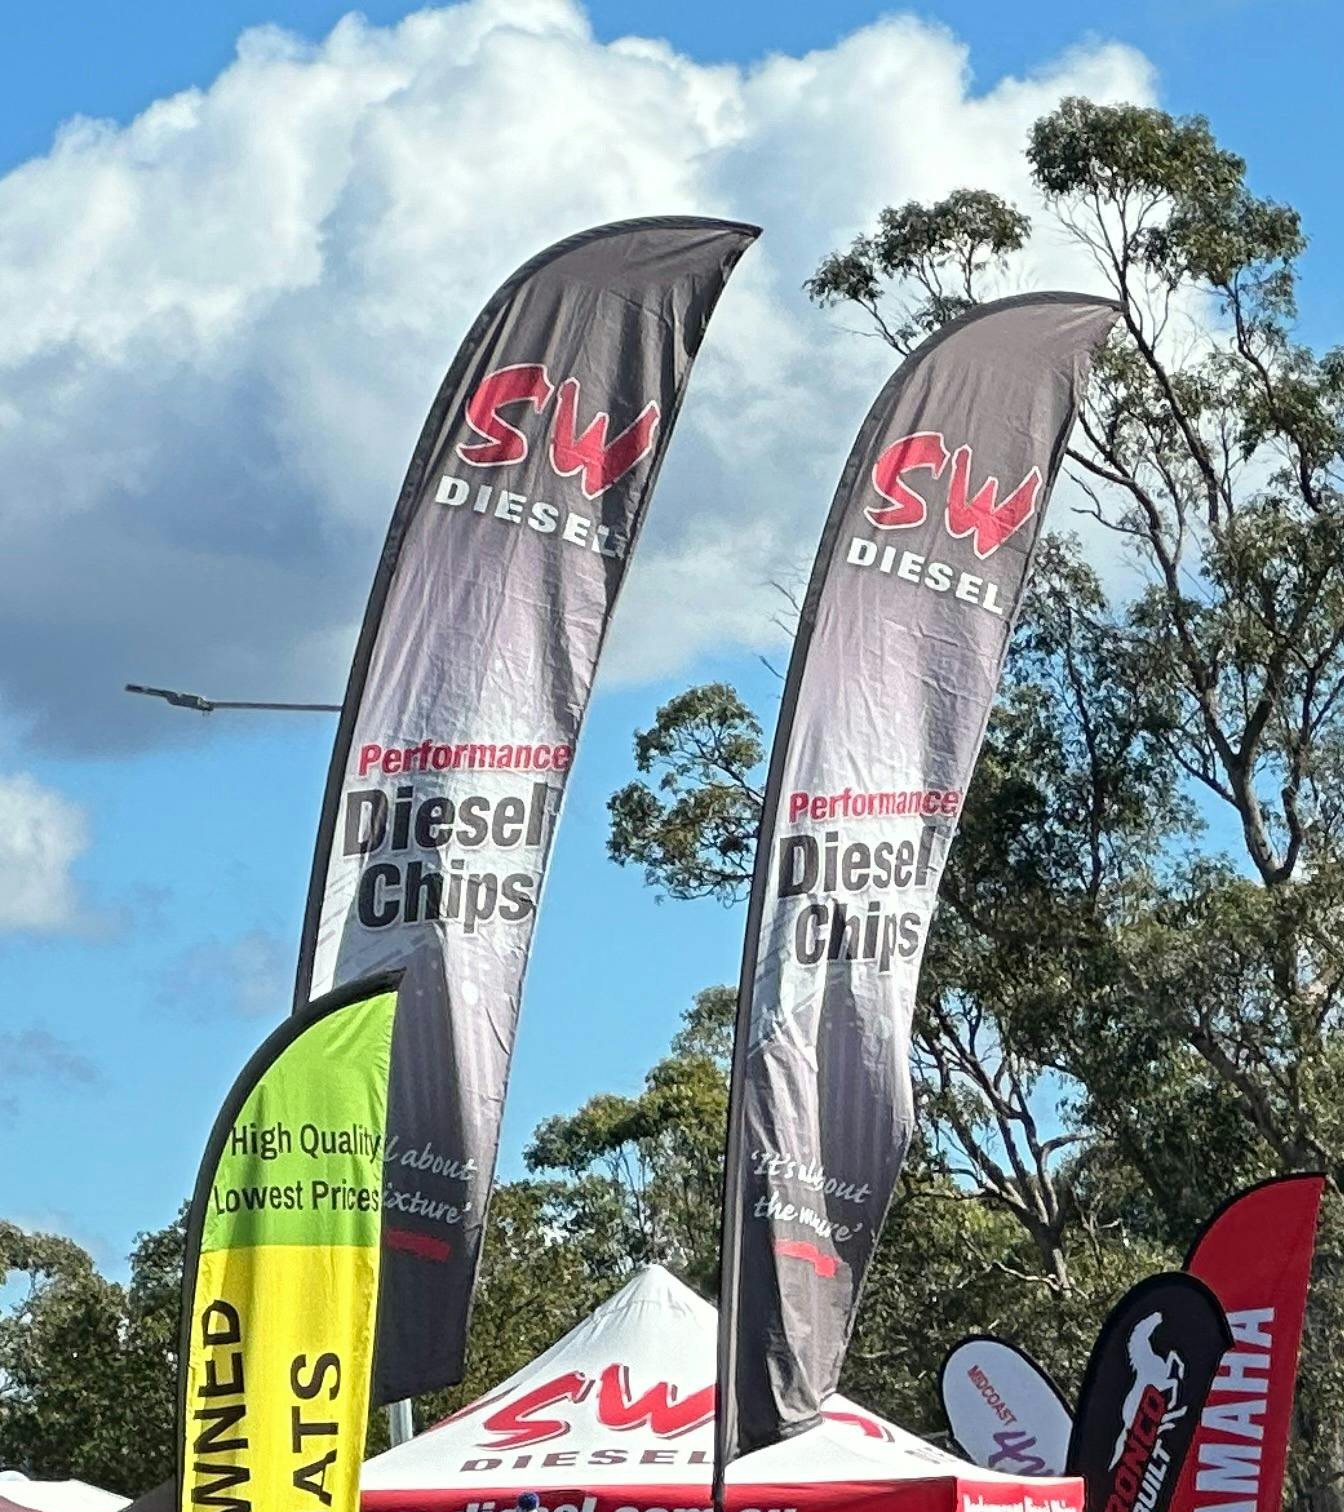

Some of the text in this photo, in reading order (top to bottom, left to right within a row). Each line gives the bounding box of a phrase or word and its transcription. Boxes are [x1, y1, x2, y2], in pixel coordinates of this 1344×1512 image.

[456, 363, 661, 500] SW
[435, 475, 626, 559] DIESEL
[864, 431, 1043, 560] SW
[847, 537, 1003, 615] DIESEL
[358, 739, 574, 776] Performance
[343, 782, 550, 857] Diesel
[788, 788, 961, 824] Performance
[778, 826, 937, 898] Diesel
[358, 859, 536, 933] Chips
[795, 901, 921, 973] Chips
[231, 1122, 291, 1160] High
[300, 1123, 381, 1163] Quality
[400, 1142, 478, 1181] about
[214, 1179, 379, 1215] Lowest Prices
[382, 1184, 472, 1224] ixture'
[967, 1364, 1018, 1426] MIDCOAST
[459, 1448, 716, 1473] DIESEL
